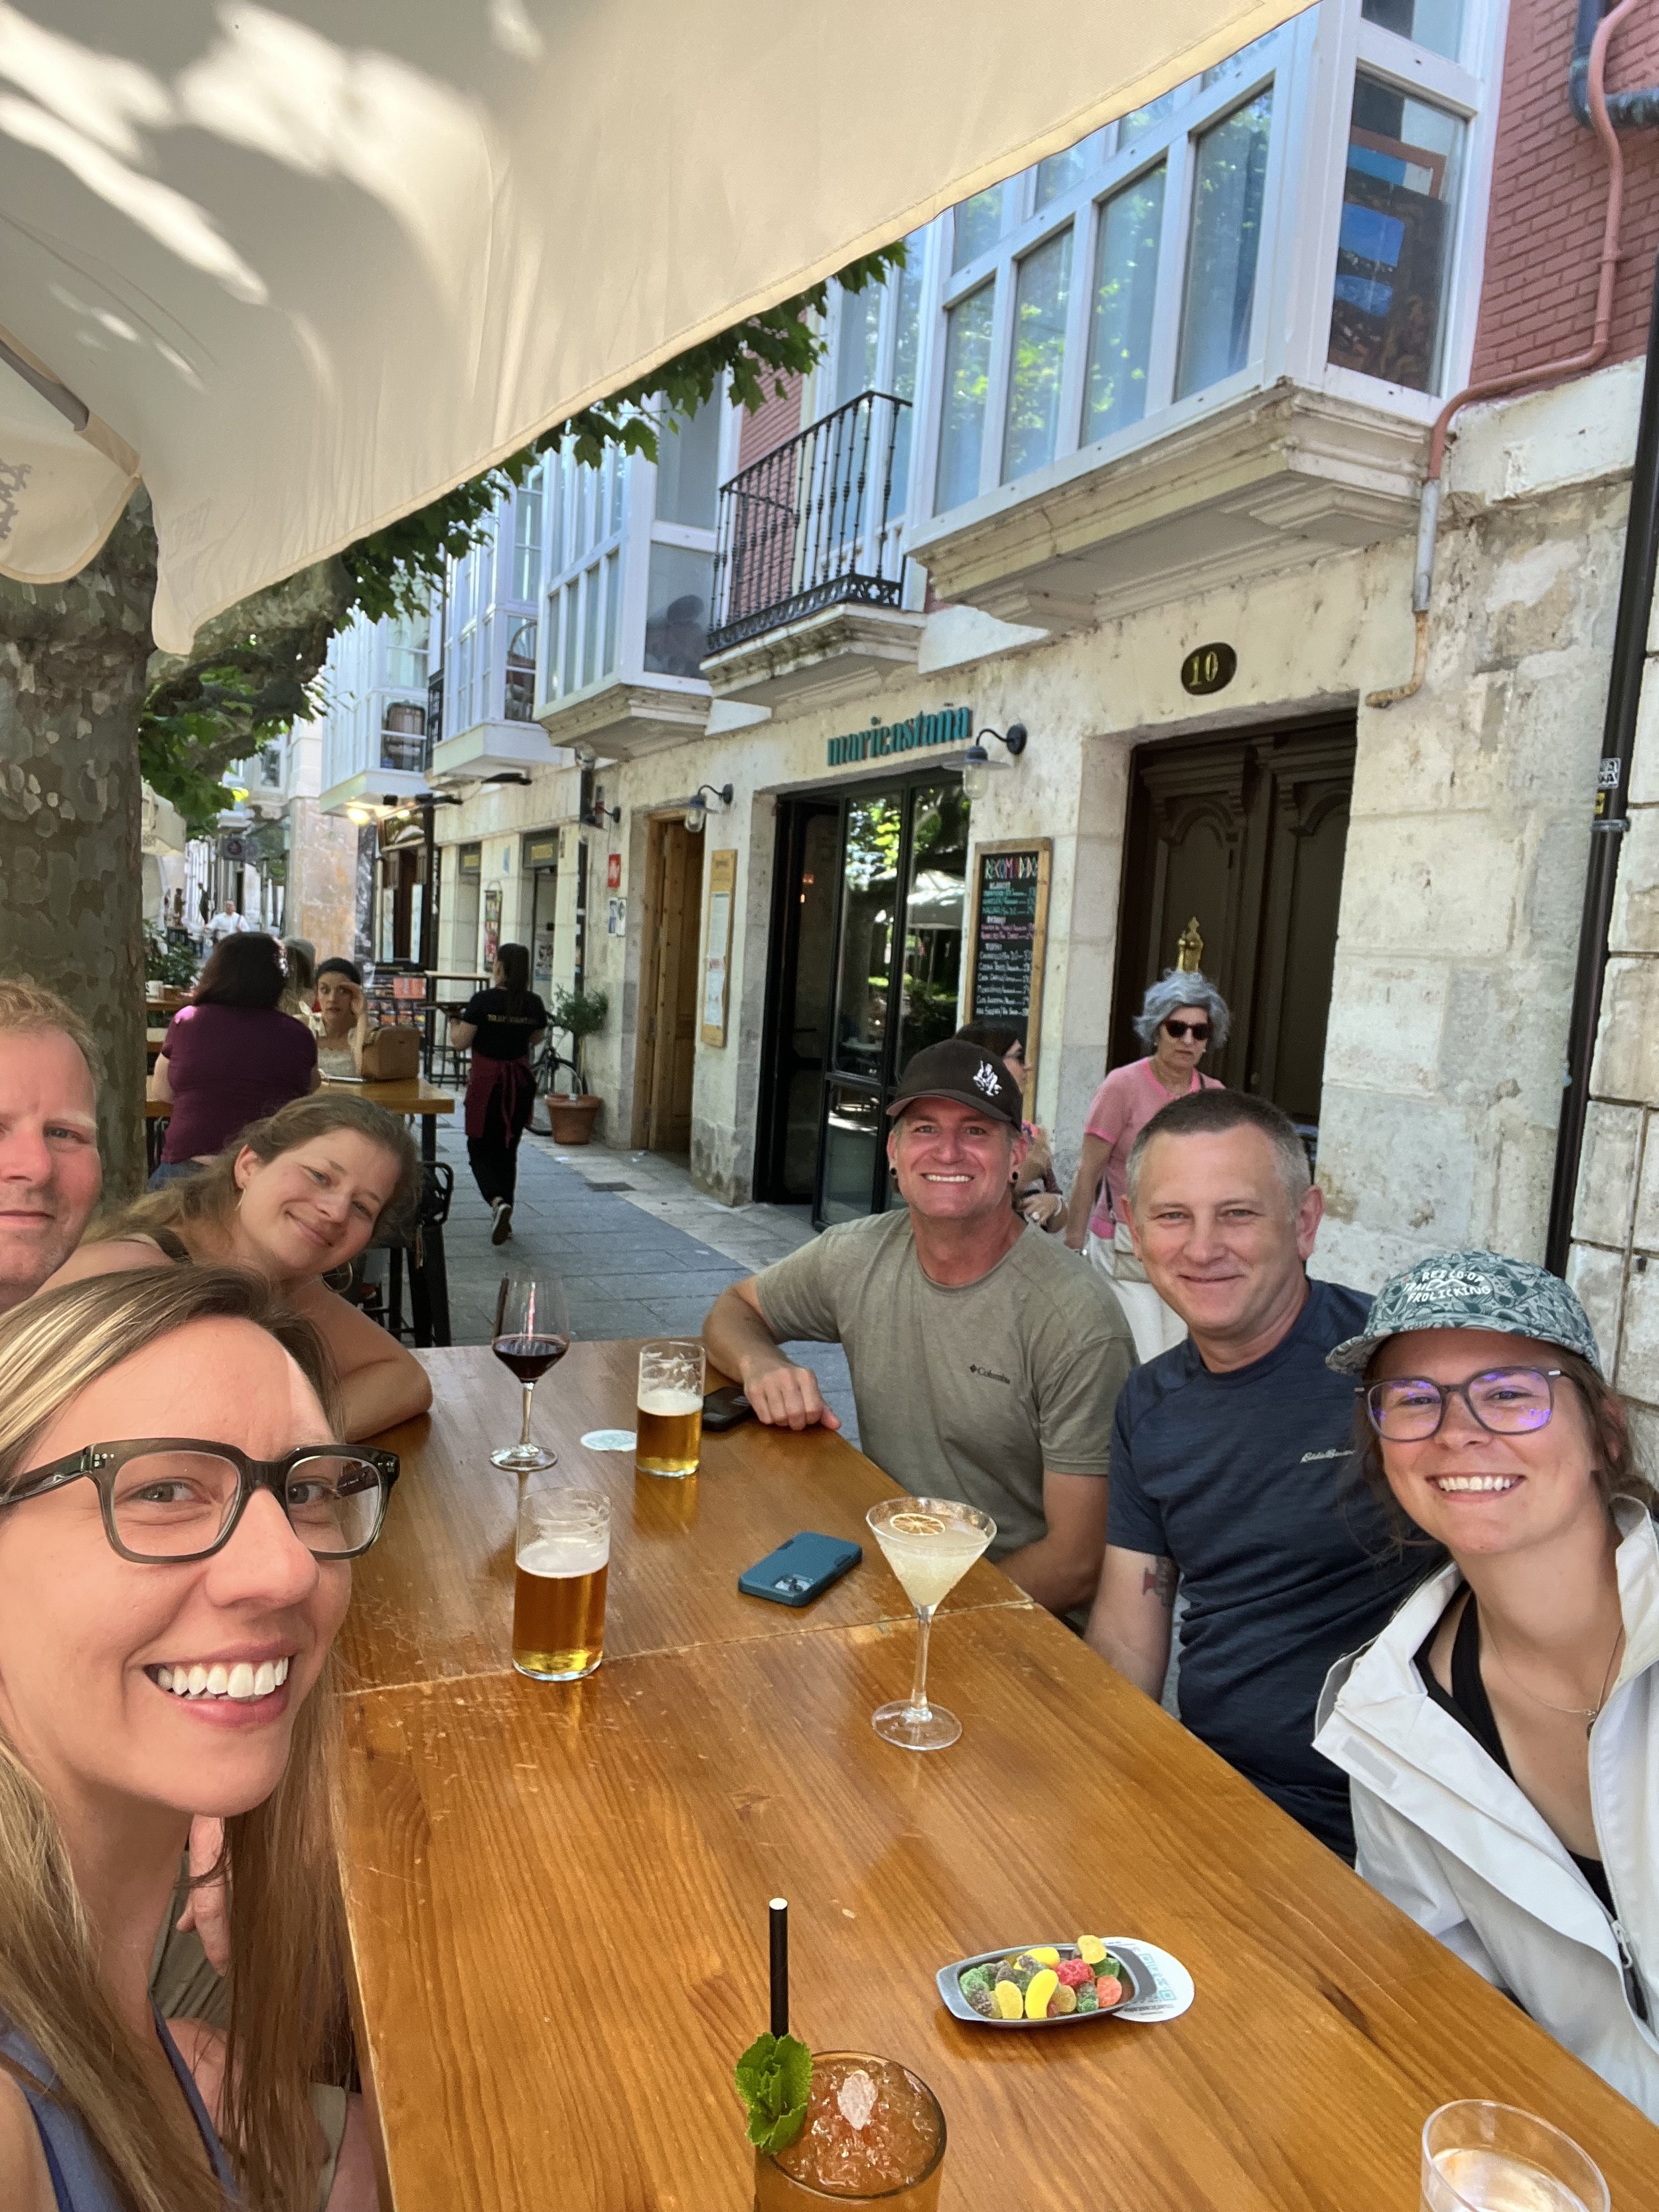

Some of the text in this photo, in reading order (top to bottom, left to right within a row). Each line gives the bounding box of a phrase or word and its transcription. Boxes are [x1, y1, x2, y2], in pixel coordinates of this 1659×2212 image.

[1189, 652, 1218, 686] 10
[1422, 1270, 1447, 1282] REI
[1402, 1282, 1433, 1293] TRAIL
[1407, 1286, 1491, 1302] FROLICKING
